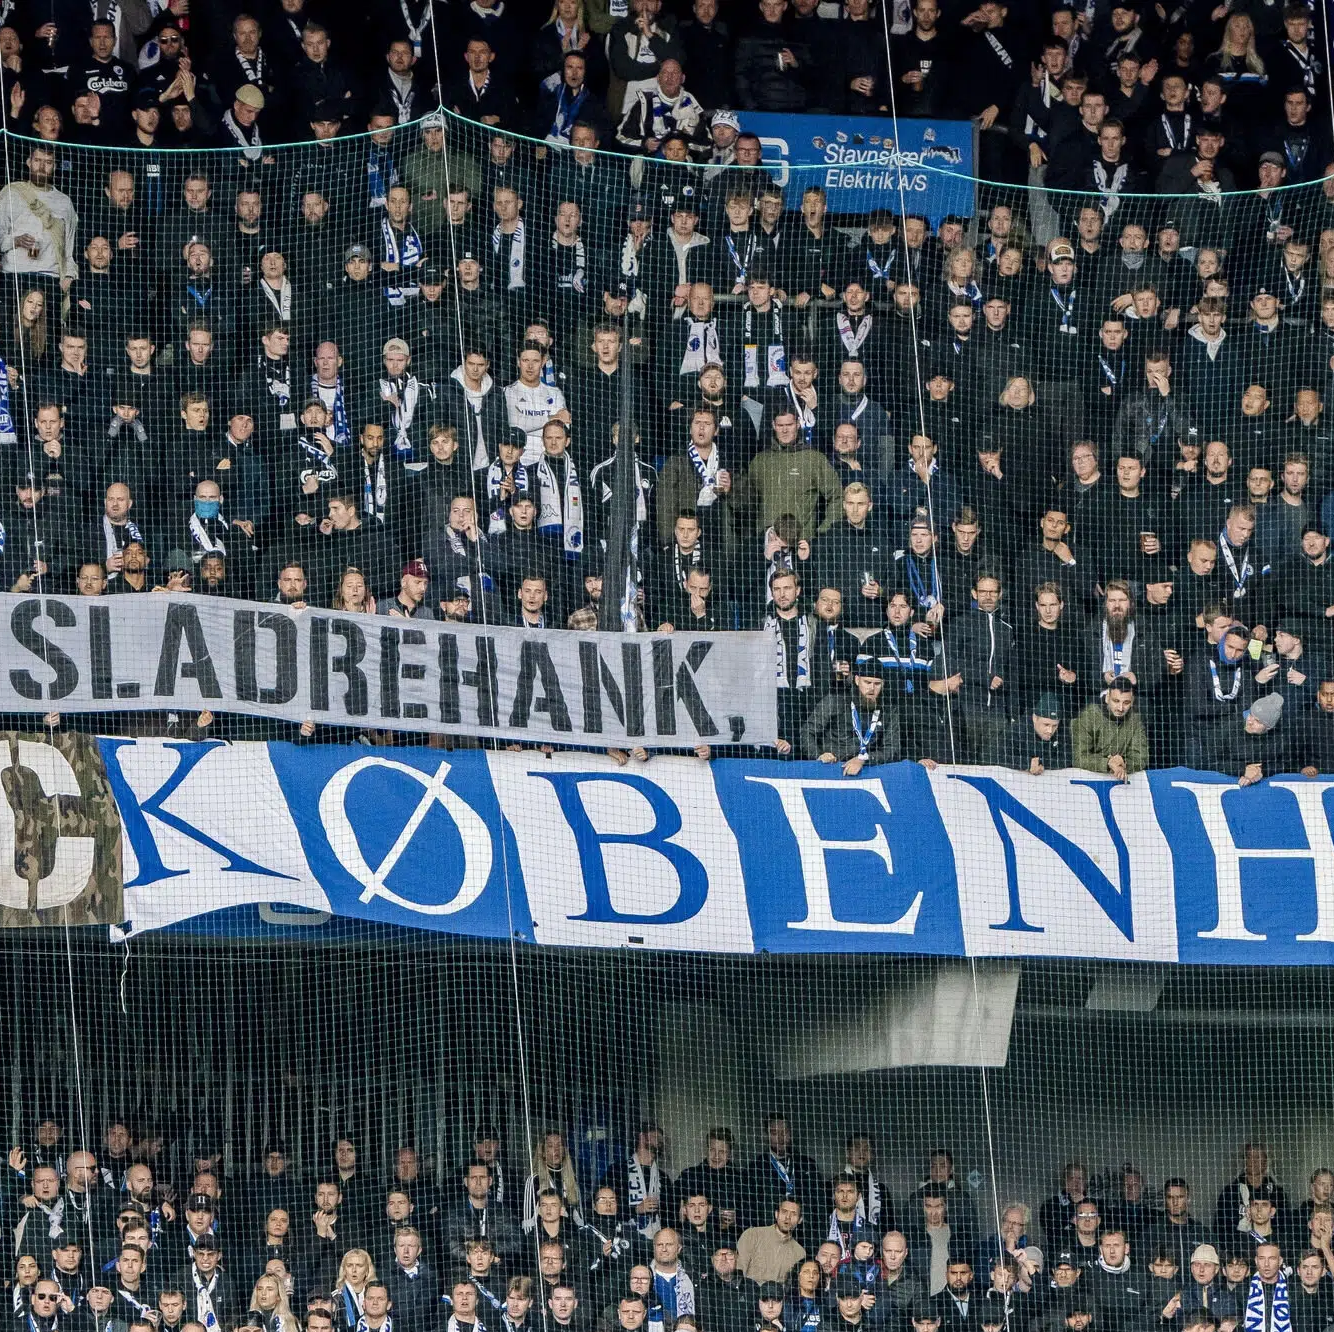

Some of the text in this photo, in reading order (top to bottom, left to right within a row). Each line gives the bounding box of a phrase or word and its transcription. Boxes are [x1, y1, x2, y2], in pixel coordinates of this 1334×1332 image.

[87, 76, 128, 93] Carlsberg
[824, 143, 927, 169] Stavnskær
[825, 169, 928, 191] Elektrik A/S
[9, 597, 746, 743] SLADREHANK,
